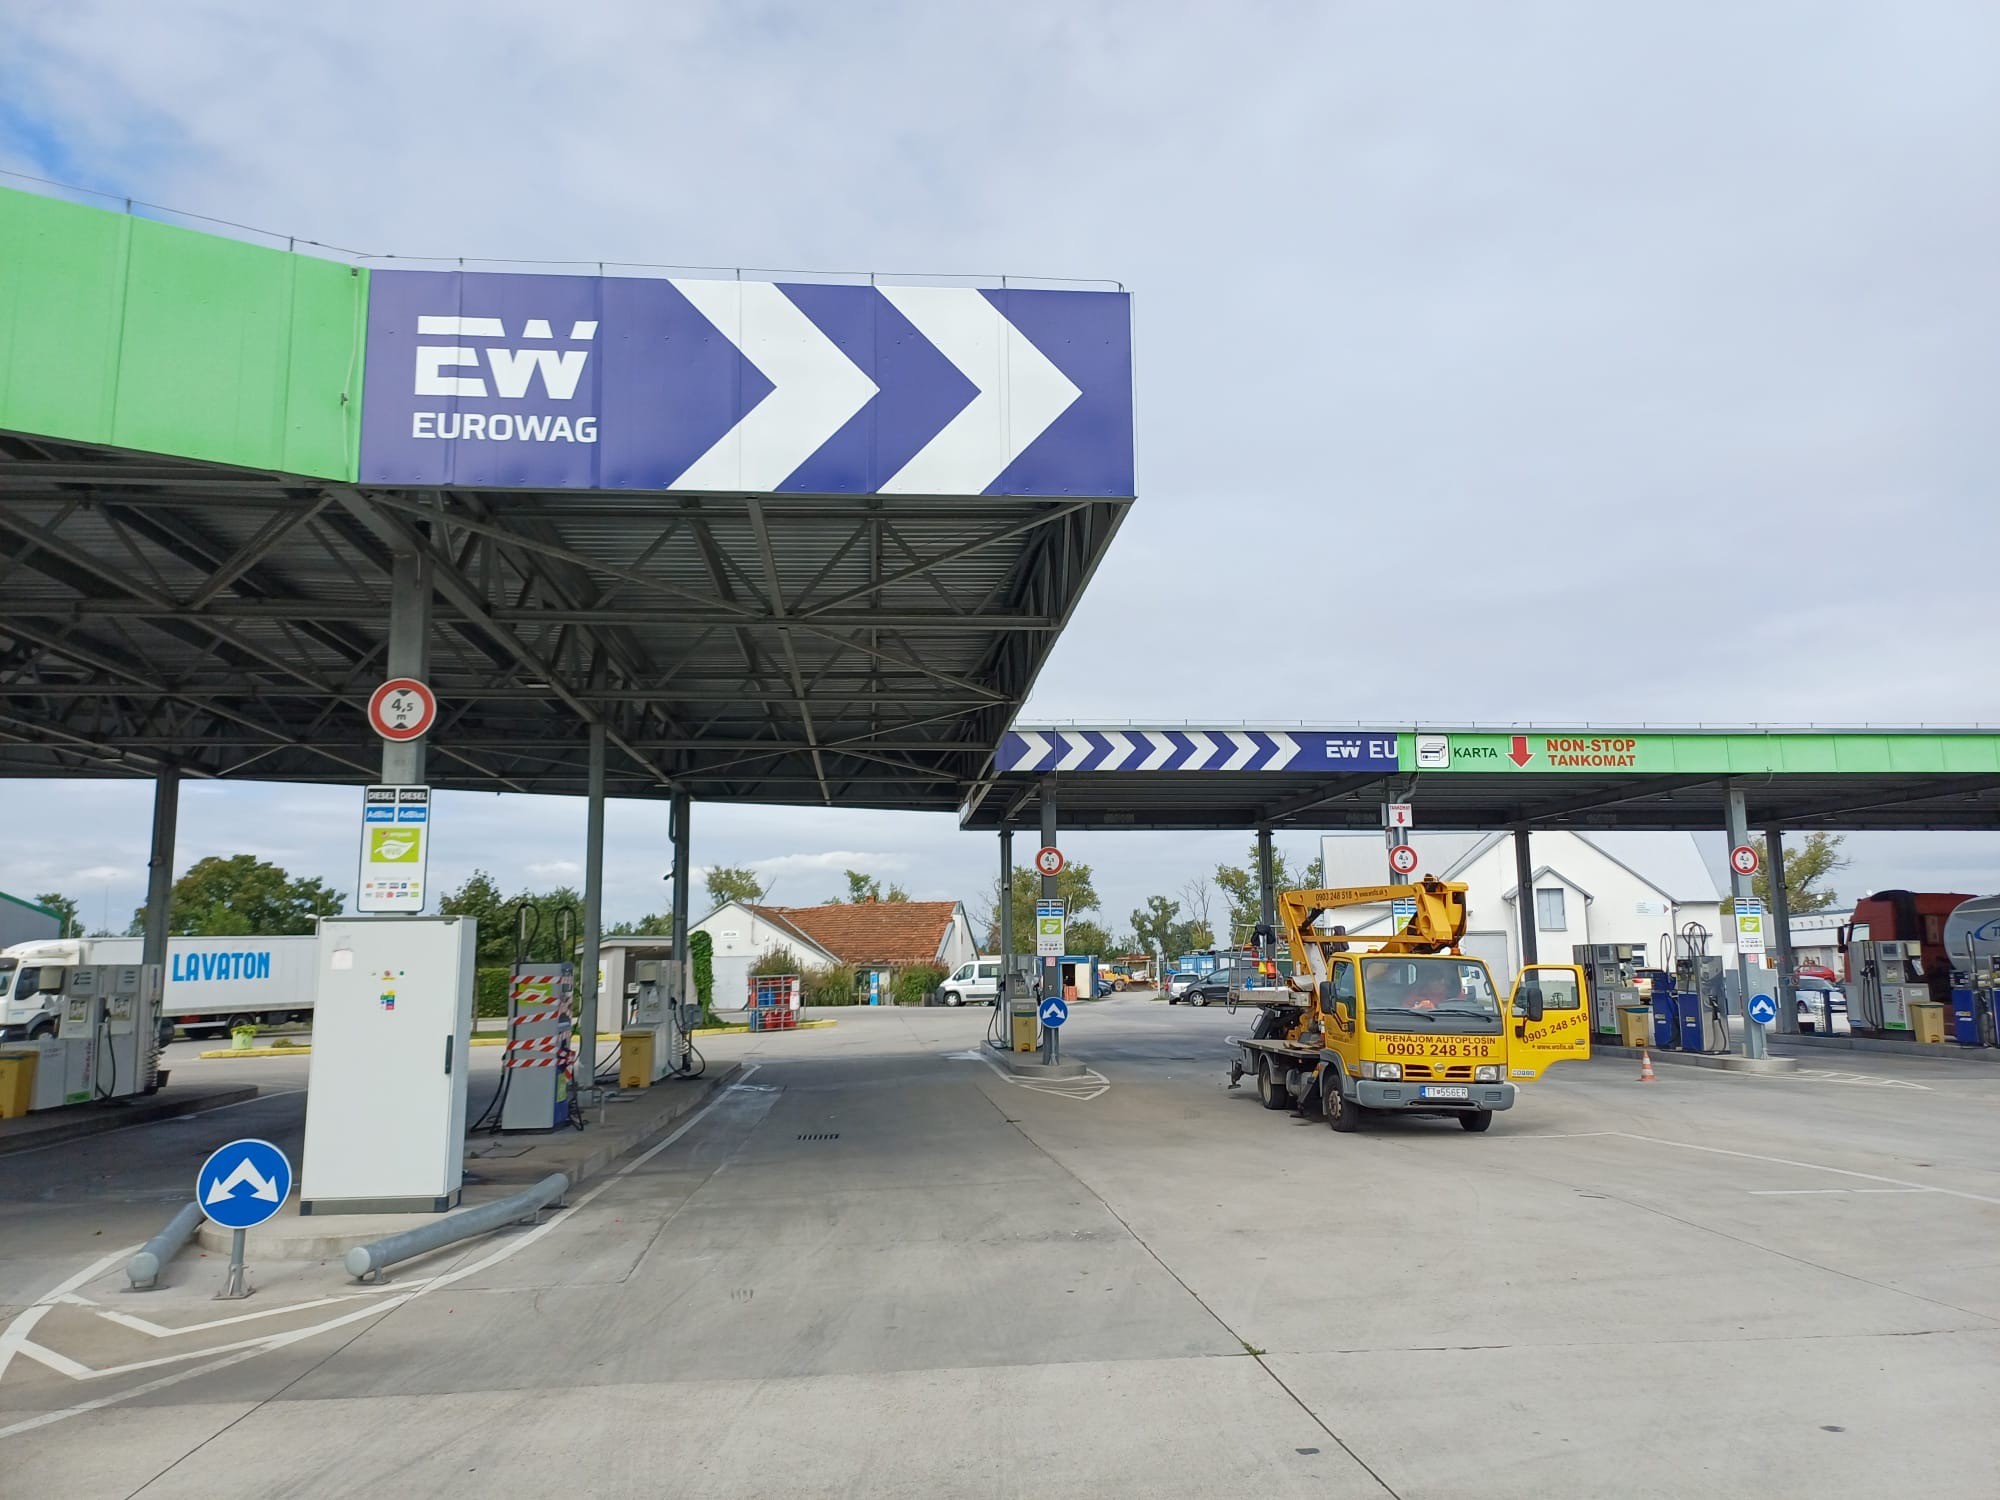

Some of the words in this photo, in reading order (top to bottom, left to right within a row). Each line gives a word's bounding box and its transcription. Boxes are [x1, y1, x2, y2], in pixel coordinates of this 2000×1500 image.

[412, 412, 598, 443] EUROWAG
[391, 698, 414, 713] 4,5
[1453, 747, 1498, 758] KARTA
[1546, 739, 1636, 752] NON-STOP
[1547, 754, 1636, 766] TANKOMAT
[368, 791, 395, 800] DIESEL
[400, 791, 427, 800] DIESEL
[172, 952, 270, 982] LAVATON
[1522, 1028, 1548, 1044] 0903
[1549, 1020, 1568, 1034] 248
[1570, 1012, 1588, 1026] 518
[1387, 1042, 1425, 1056] 0903
[1430, 1043, 1457, 1056] 248
[1462, 1045, 1489, 1057] 518
